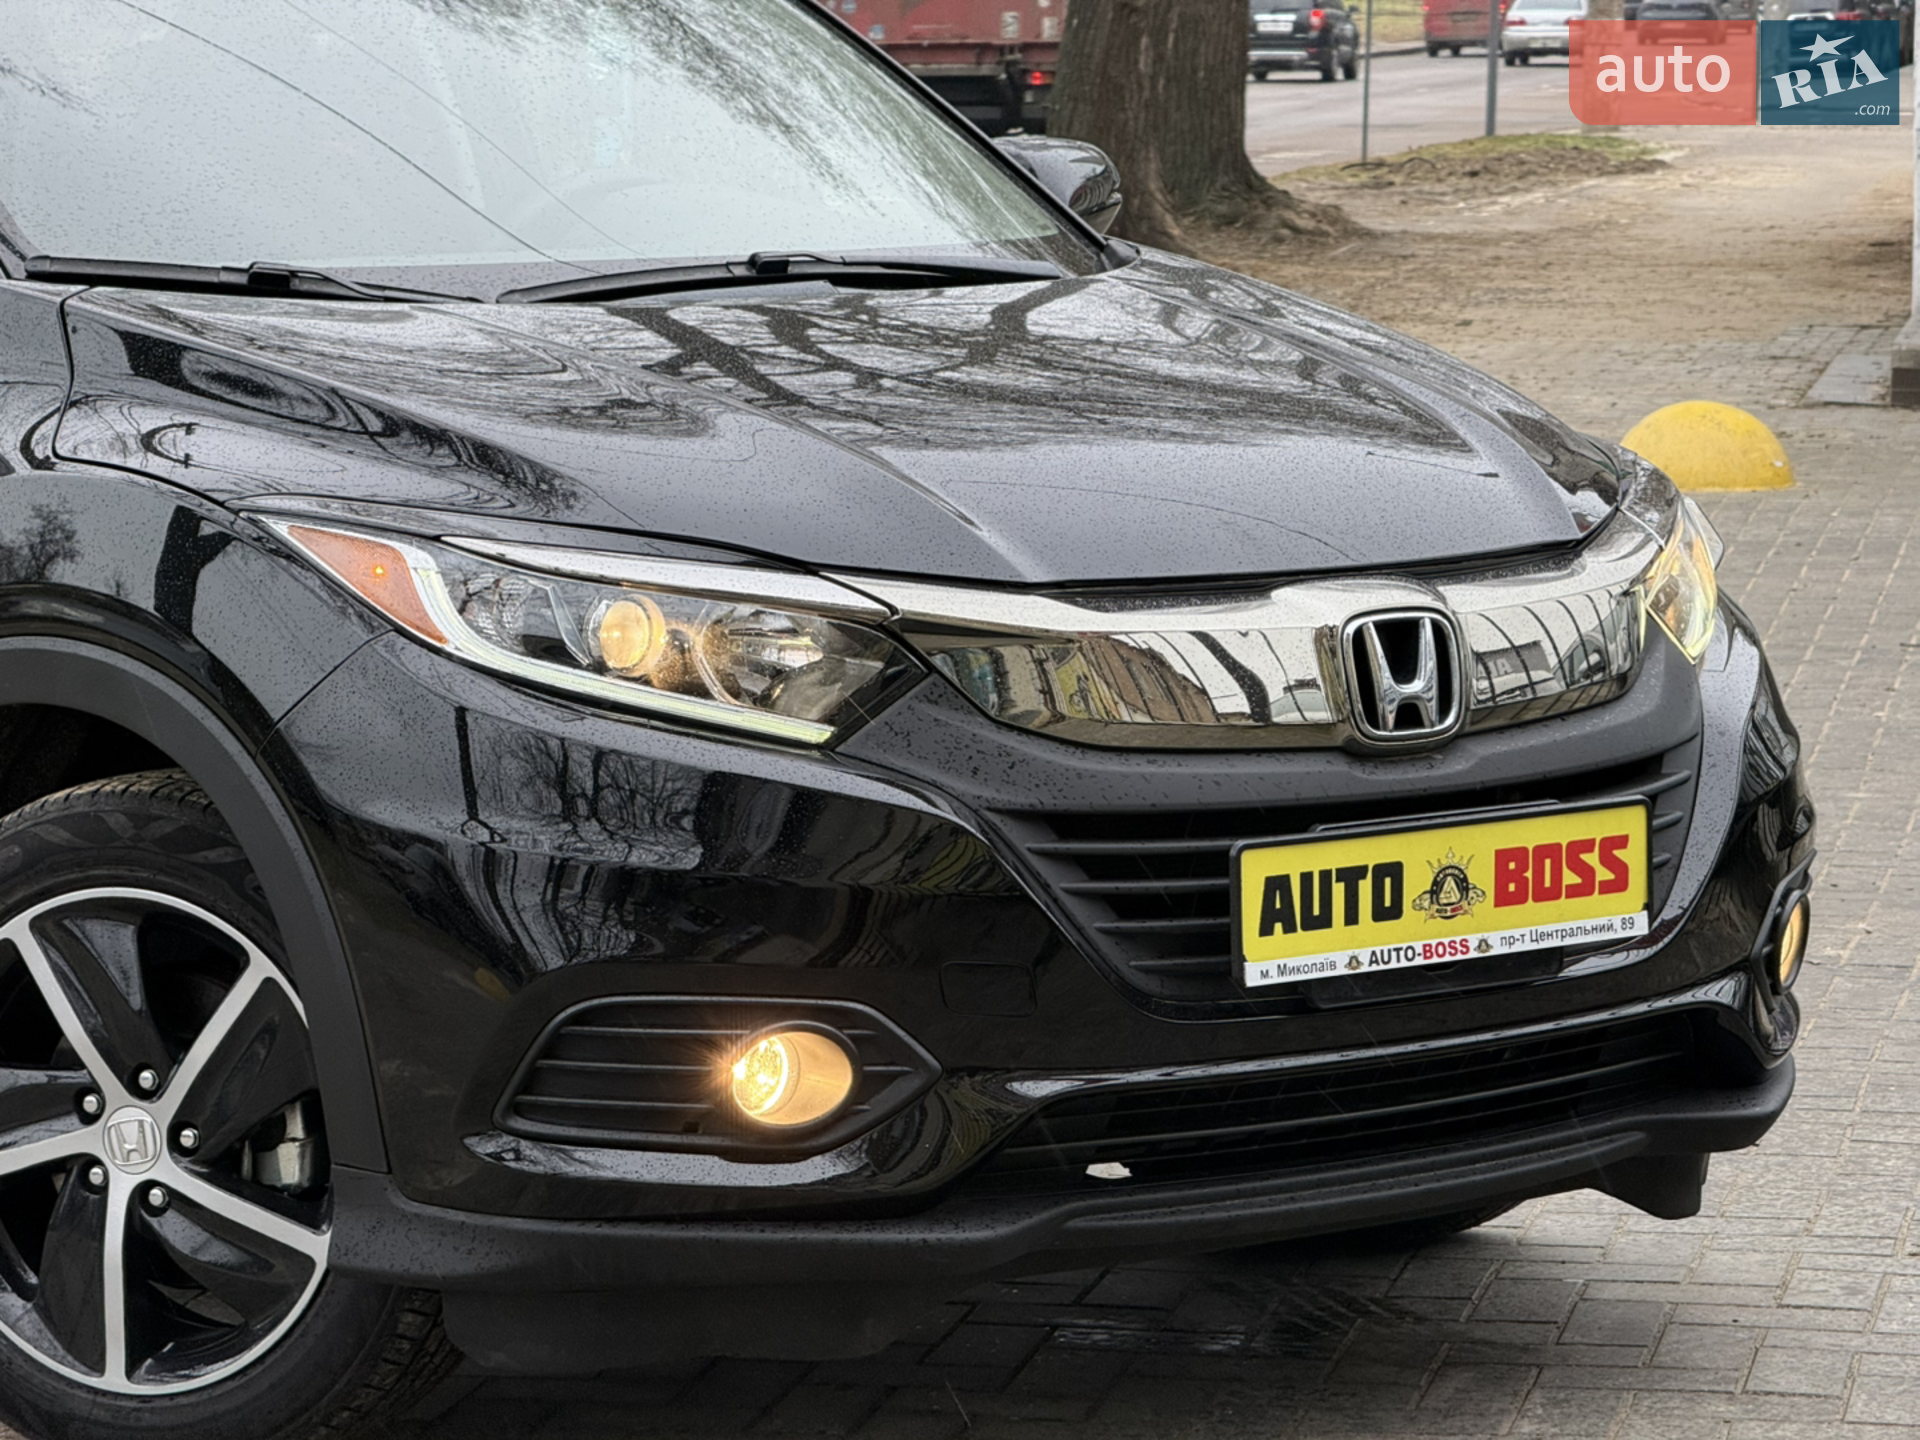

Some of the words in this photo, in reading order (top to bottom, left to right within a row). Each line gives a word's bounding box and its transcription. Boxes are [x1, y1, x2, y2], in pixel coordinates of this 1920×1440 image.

[1258, 861, 1404, 937] AUTO
[1494, 834, 1630, 908] BOSS
[1500, 933, 1526, 949] пр-т
[1529, 919, 1617, 943] Центральний,
[1620, 916, 1635, 931] 89
[1277, 957, 1337, 977] Миколаїв
[1368, 938, 1470, 967] AUTO-BOSS
